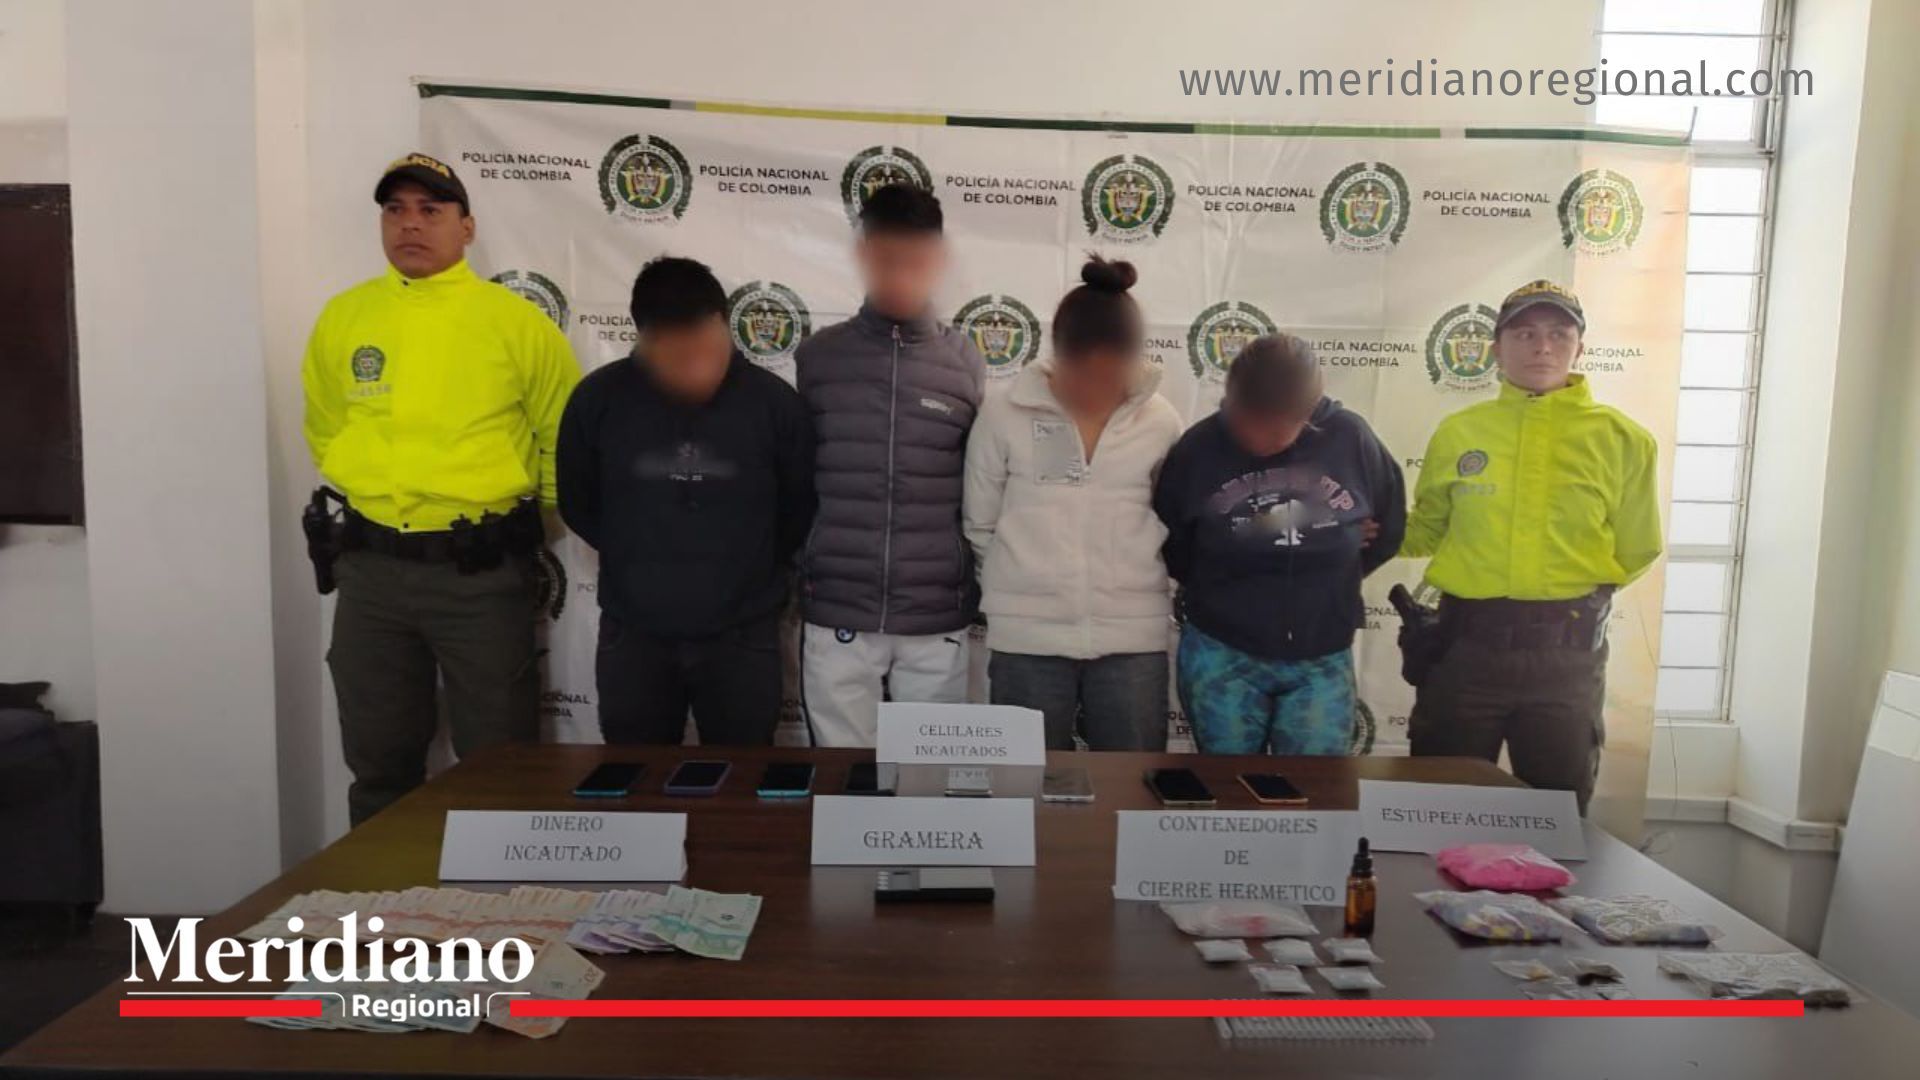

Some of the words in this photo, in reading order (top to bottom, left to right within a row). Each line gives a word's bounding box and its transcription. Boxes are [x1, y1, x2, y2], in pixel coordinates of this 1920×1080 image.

[518, 152, 592, 169] NACIONAL
[480, 168, 500, 179] DE
[502, 169, 572, 181] COLOMBIA
[757, 167, 830, 181] NACIONAL
[718, 182, 736, 193] DE
[739, 183, 812, 196] COLOMBIA
[1004, 178, 1077, 192] NACIONAL
[963, 192, 981, 204] DE
[984, 193, 1059, 206] COLOMBIA
[1246, 186, 1316, 199] NACIONAL
[1480, 191, 1551, 204] NACIONAL
[1203, 201, 1222, 212] DE
[1225, 201, 1297, 213] COLOMBIA
[1440, 205, 1458, 216] DE
[1461, 206, 1532, 218] COLOMBIA
[598, 331, 616, 341] DE
[1144, 338, 1184, 349] ONAL
[1310, 338, 1346, 352] LICÍA
[1349, 341, 1417, 354] NACIONAL
[1583, 347, 1645, 358] ACIONAL
[1331, 356, 1400, 367] COLOMBIA
[1578, 361, 1625, 372] LOMBIA
[918, 724, 1004, 738] CELULARES
[915, 744, 1008, 758] INCAUTADOS
[529, 815, 604, 833] DINERO
[1158, 815, 1319, 835] CONTENEDORES
[1380, 807, 1557, 831] ESTUPEFACIENTES
[862, 829, 985, 851] GRAMERA
[503, 844, 623, 862] INCAUTADO
[1223, 849, 1250, 866] DE
[1137, 880, 1212, 899] CIERRE
[1218, 882, 1336, 902] HERMETICO
